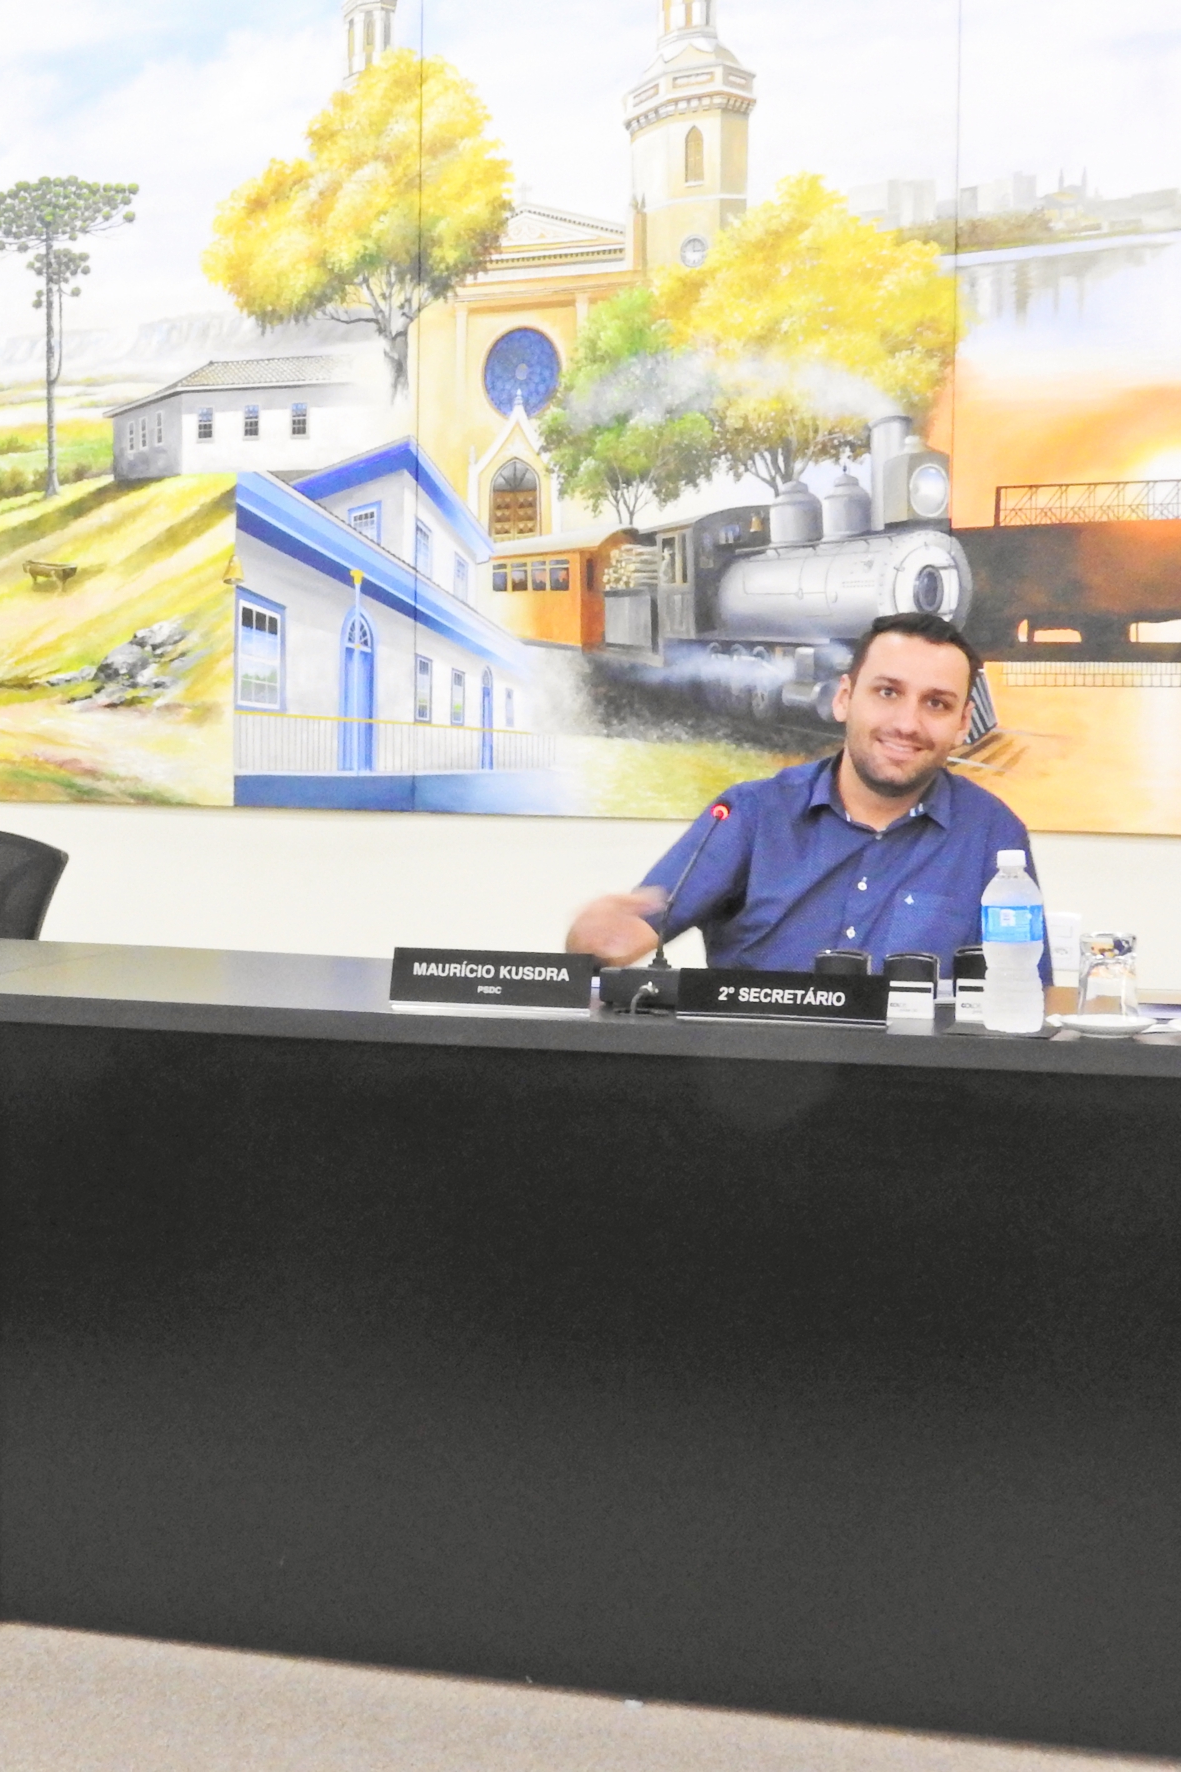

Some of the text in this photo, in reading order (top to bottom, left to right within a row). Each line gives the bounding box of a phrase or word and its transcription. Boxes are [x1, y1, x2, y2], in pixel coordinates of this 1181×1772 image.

[412, 960, 570, 982] MAURÍCIO KUSDRA
[476, 984, 503, 995] PSDC
[737, 987, 846, 1007] SECRETÁRIO
